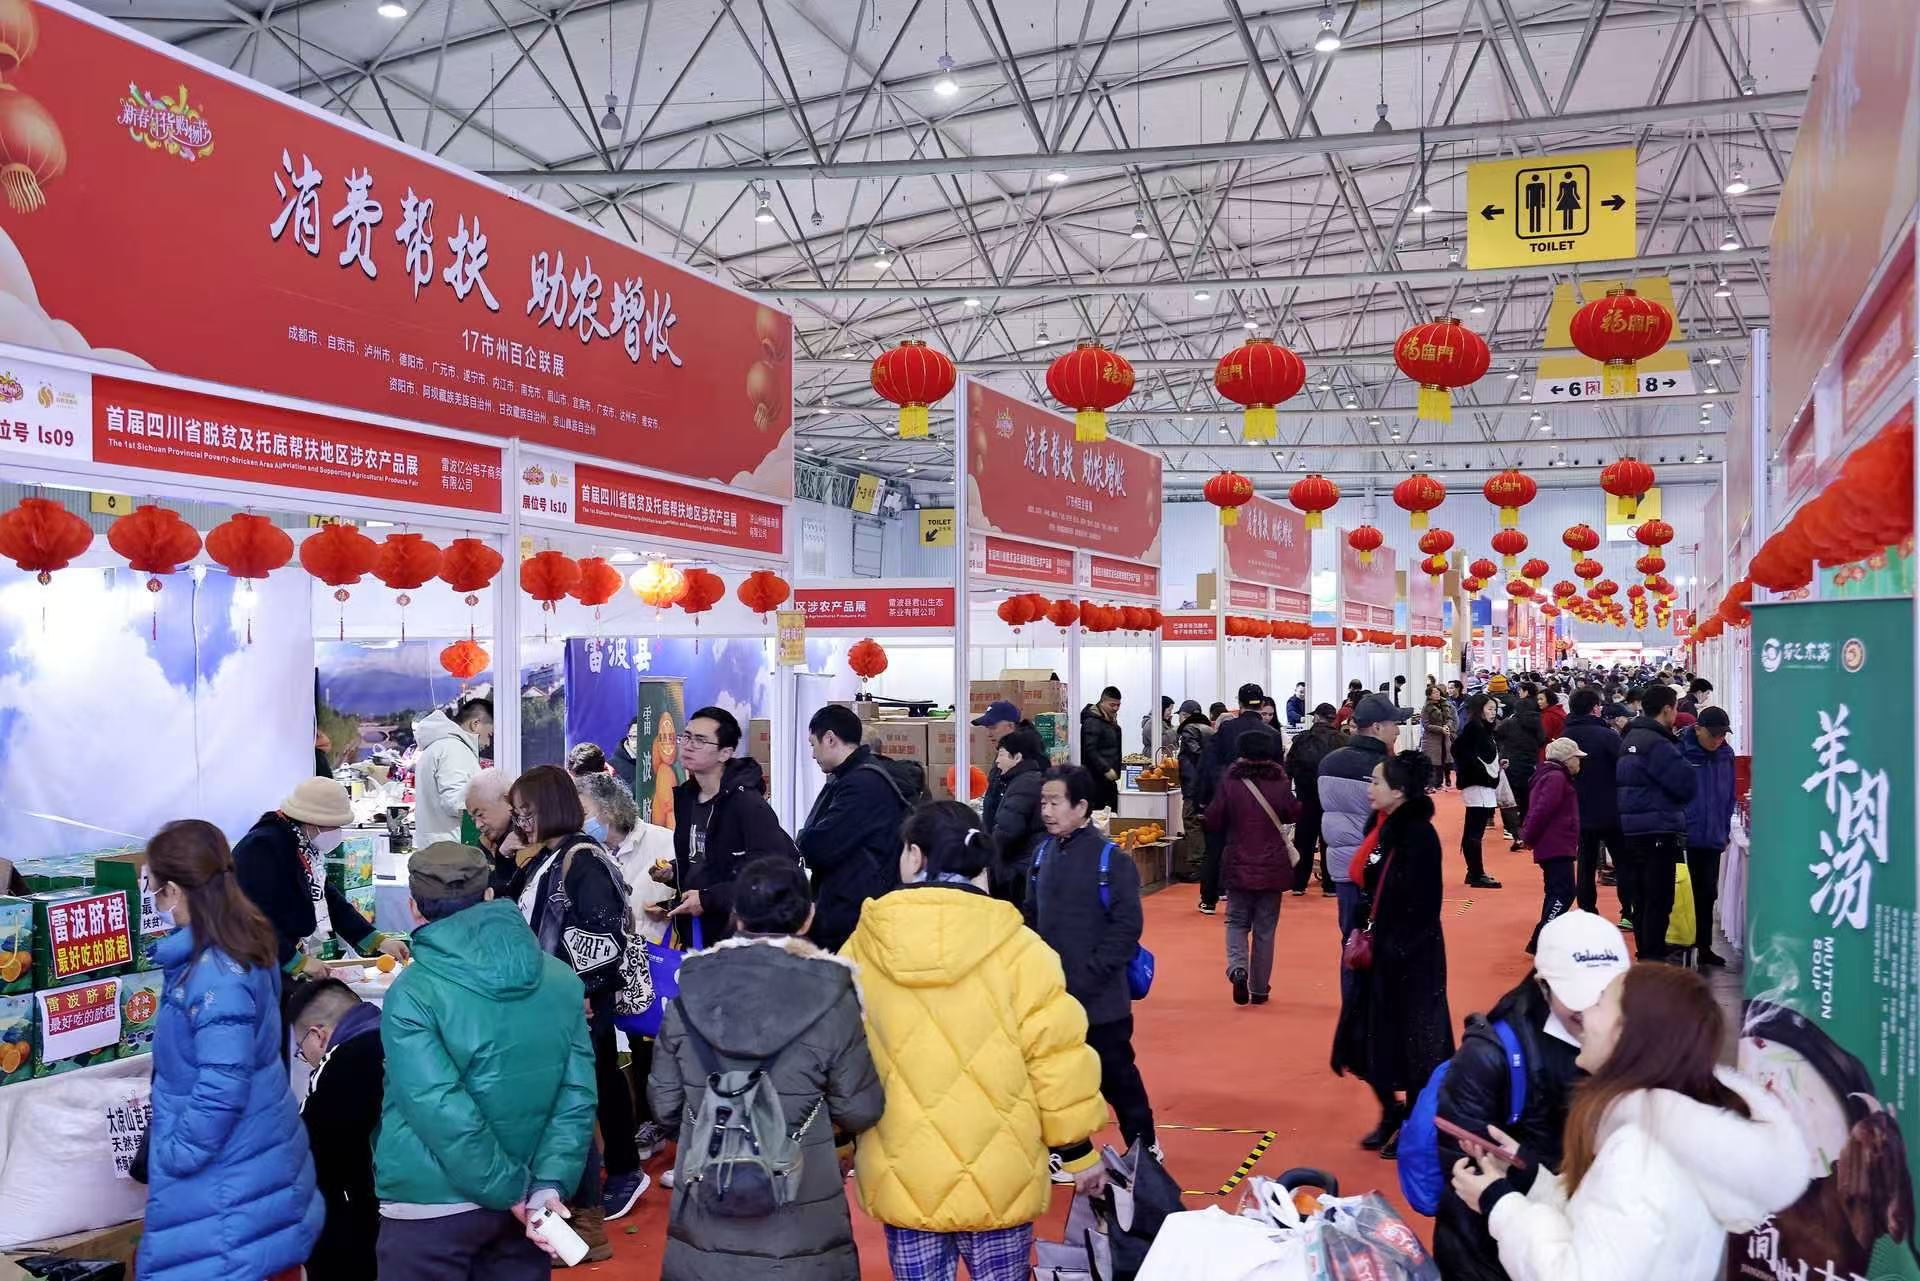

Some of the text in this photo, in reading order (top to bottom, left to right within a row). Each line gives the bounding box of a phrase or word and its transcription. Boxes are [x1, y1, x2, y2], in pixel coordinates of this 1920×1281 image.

[269, 147, 684, 367] 消费帮扶 助农增收
[1529, 240, 1575, 253] TOILET
[462, 328, 566, 377] 17市州百企联展
[1568, 382, 1581, 396] 6
[1645, 378, 1658, 392] 8
[105, 405, 419, 476] 首届四川省脱贫及托底帮扶地区涉农产品展
[108, 438, 122, 448] The
[124, 441, 136, 449] 1st
[137, 442, 166, 454] Sichuan
[167, 447, 202, 459] Provincial
[204, 452, 259, 467] Poverty-Stricken
[259, 461, 274, 469] Area
[308, 465, 319, 473] and
[320, 467, 351, 478] Supporting
[441, 475, 473, 493] 有限公司
[522, 495, 547, 512] 展位号
[795, 600, 866, 613] 区涉农产品展
[1802, 703, 1888, 930] 羊肉汤
[51, 896, 126, 944] 雷波脐橙
[57, 935, 129, 974] 最好吃的脐橙
[1811, 937, 1822, 991] SOUP
[1823, 936, 1835, 1019] MUTTON
[47, 983, 117, 1012] 雷波脐橙
[49, 1002, 116, 1033] 最好吃的脐橙
